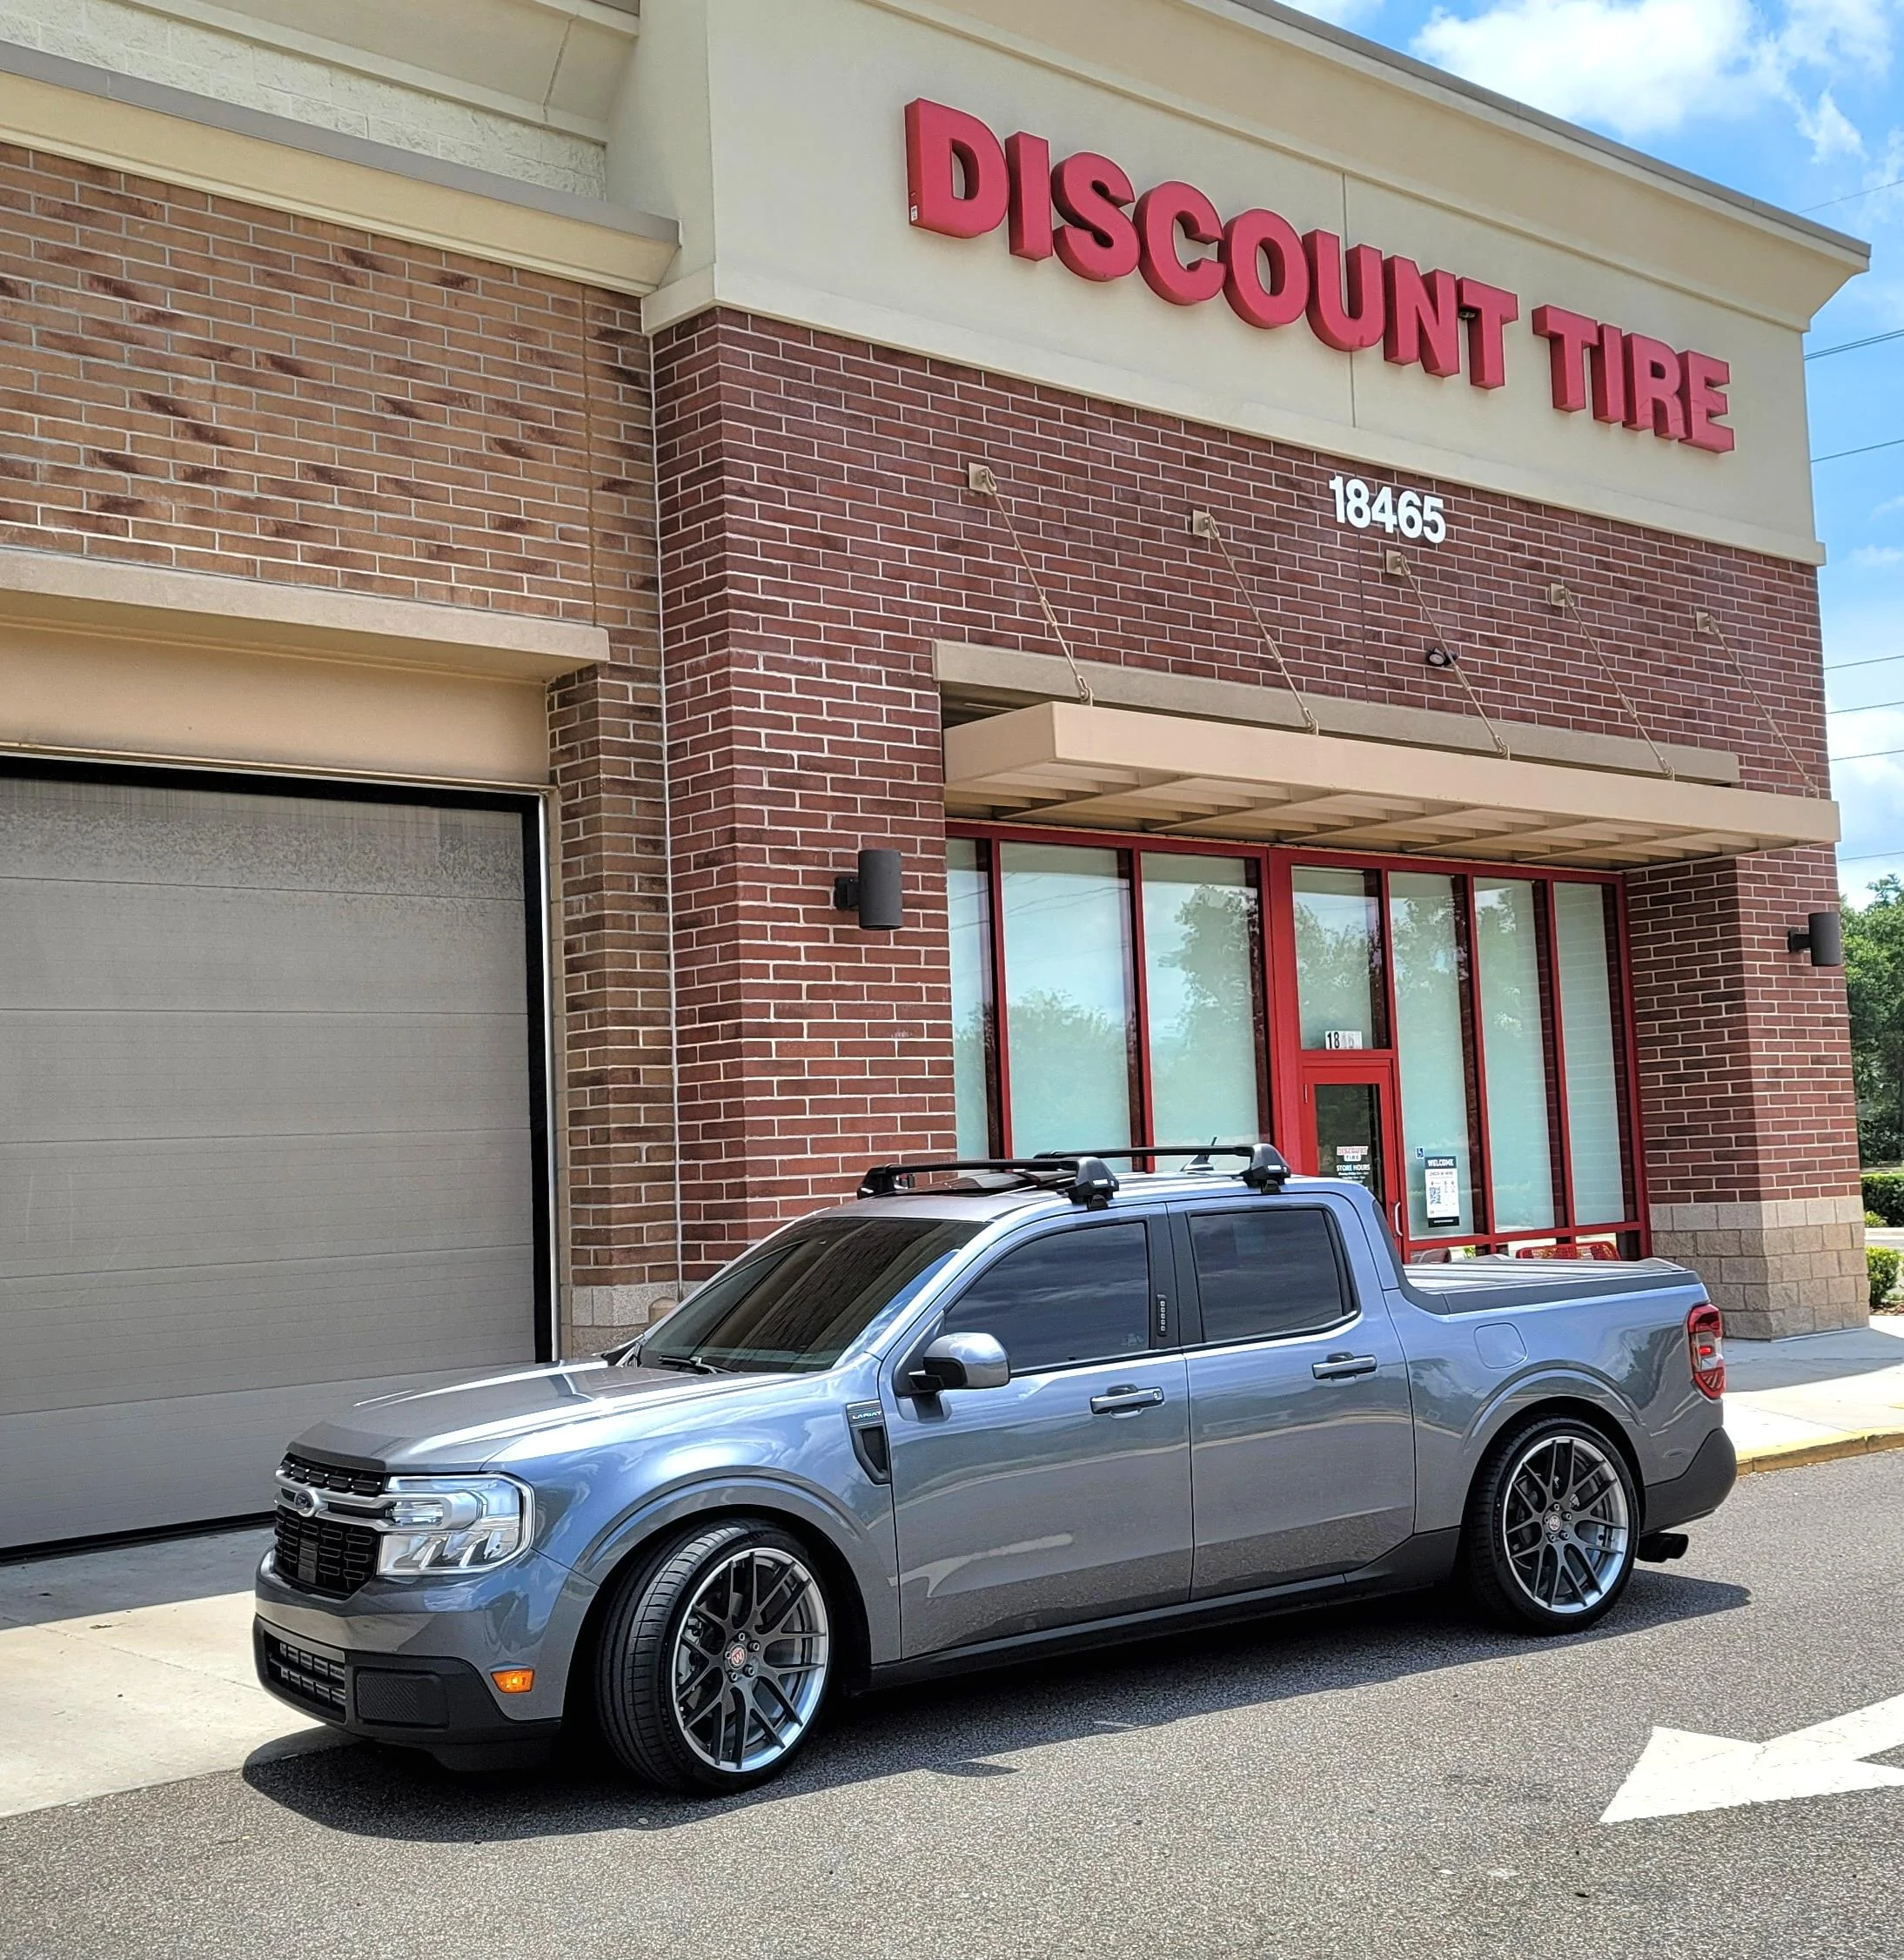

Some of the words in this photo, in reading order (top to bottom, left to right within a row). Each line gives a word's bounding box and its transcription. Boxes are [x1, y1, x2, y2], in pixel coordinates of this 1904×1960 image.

[904, 97, 1519, 389] DISCOUNT
[1532, 305, 1734, 453] TIRE
[1329, 475, 1446, 544] 18465
[1427, 1158, 1454, 1167] WELCOME
